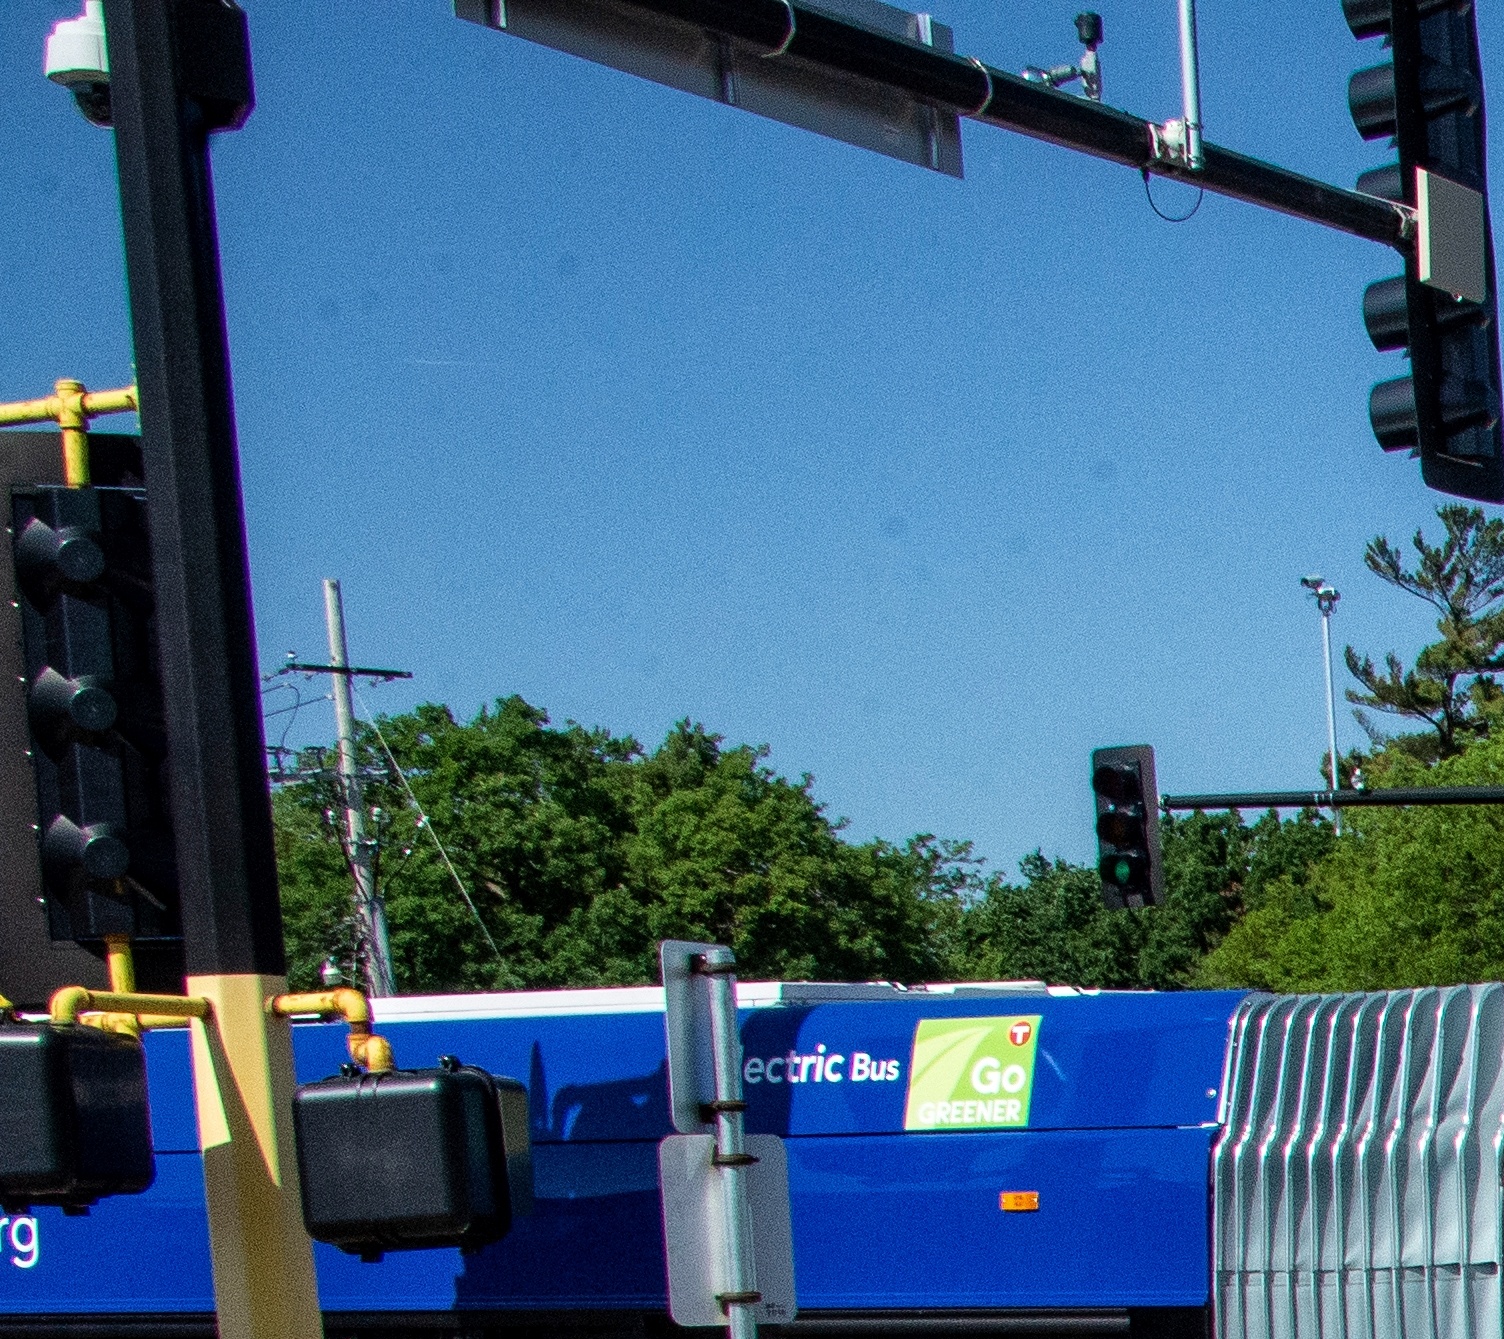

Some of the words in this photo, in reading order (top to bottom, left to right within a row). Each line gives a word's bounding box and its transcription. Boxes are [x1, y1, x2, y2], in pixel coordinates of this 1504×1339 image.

[743, 1043, 845, 1083] ectric
[850, 1052, 900, 1082] Bus
[971, 1056, 1026, 1094] Go
[917, 1099, 1022, 1125] GREENER
